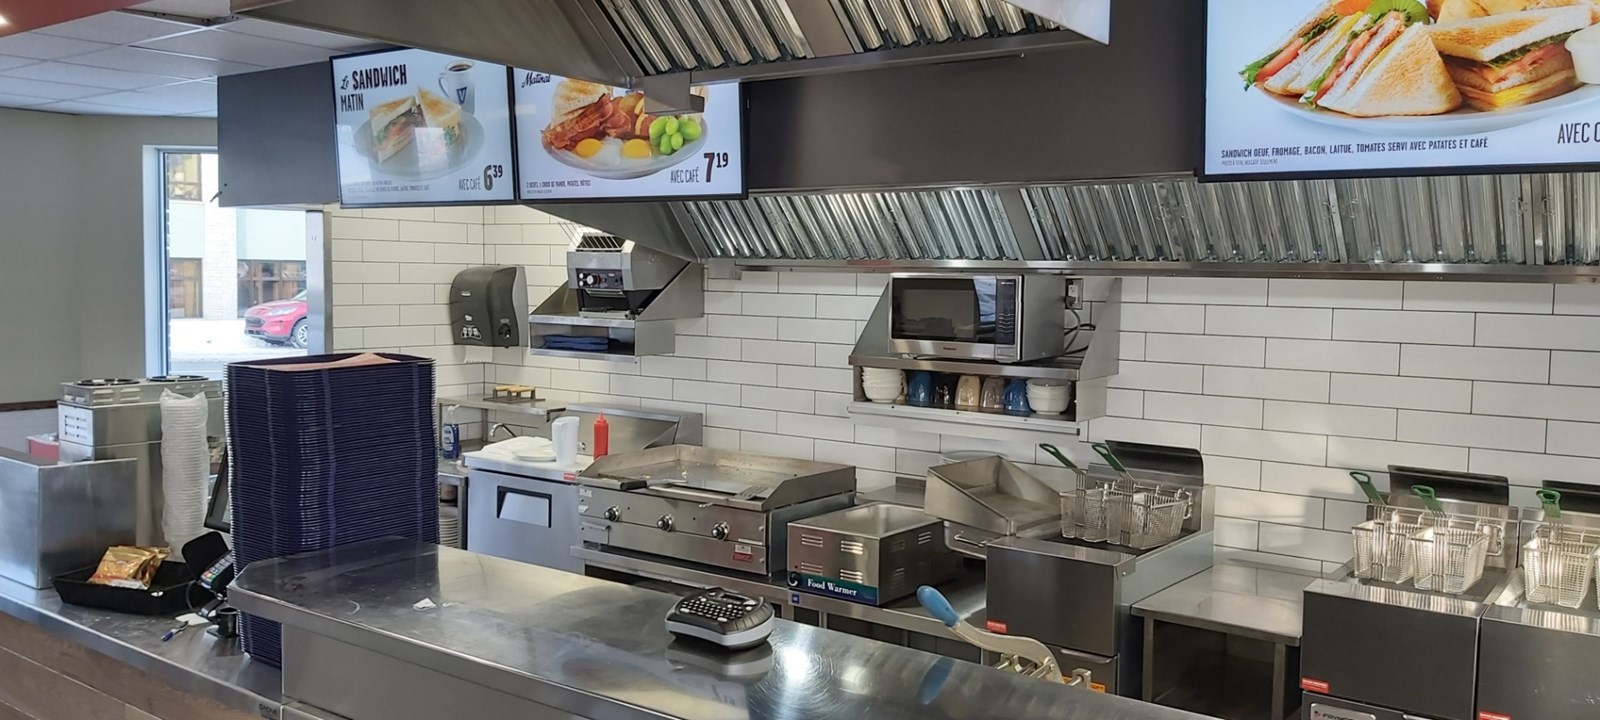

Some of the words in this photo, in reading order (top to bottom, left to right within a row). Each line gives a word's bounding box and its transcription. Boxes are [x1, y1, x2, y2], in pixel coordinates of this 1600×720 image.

[352, 64, 408, 90] SANDWICH
[340, 93, 364, 112] MATIN
[1557, 122, 1590, 144] AVEC
[1221, 149, 1252, 159] SANDWICH
[1254, 148, 1270, 157] OEUF,
[1271, 146, 1302, 156] FROMAGE,
[1304, 144, 1327, 155] BACON,
[1329, 144, 1354, 154] LAITUE,
[1356, 142, 1386, 153] TOMATES
[1388, 141, 1408, 151] SERVI
[1410, 140, 1426, 150] AVEC
[1428, 139, 1457, 150] PATATES
[1459, 138, 1468, 149] ET
[1470, 136, 1488, 148] CAFÉ
[458, 178, 470, 191] AVEC
[470, 176, 481, 190] CAFÉ
[670, 170, 684, 184] AVEC
[685, 166, 699, 183] CAFÉ
[807, 578, 825, 590] Food
[827, 582, 858, 596] Warmer
